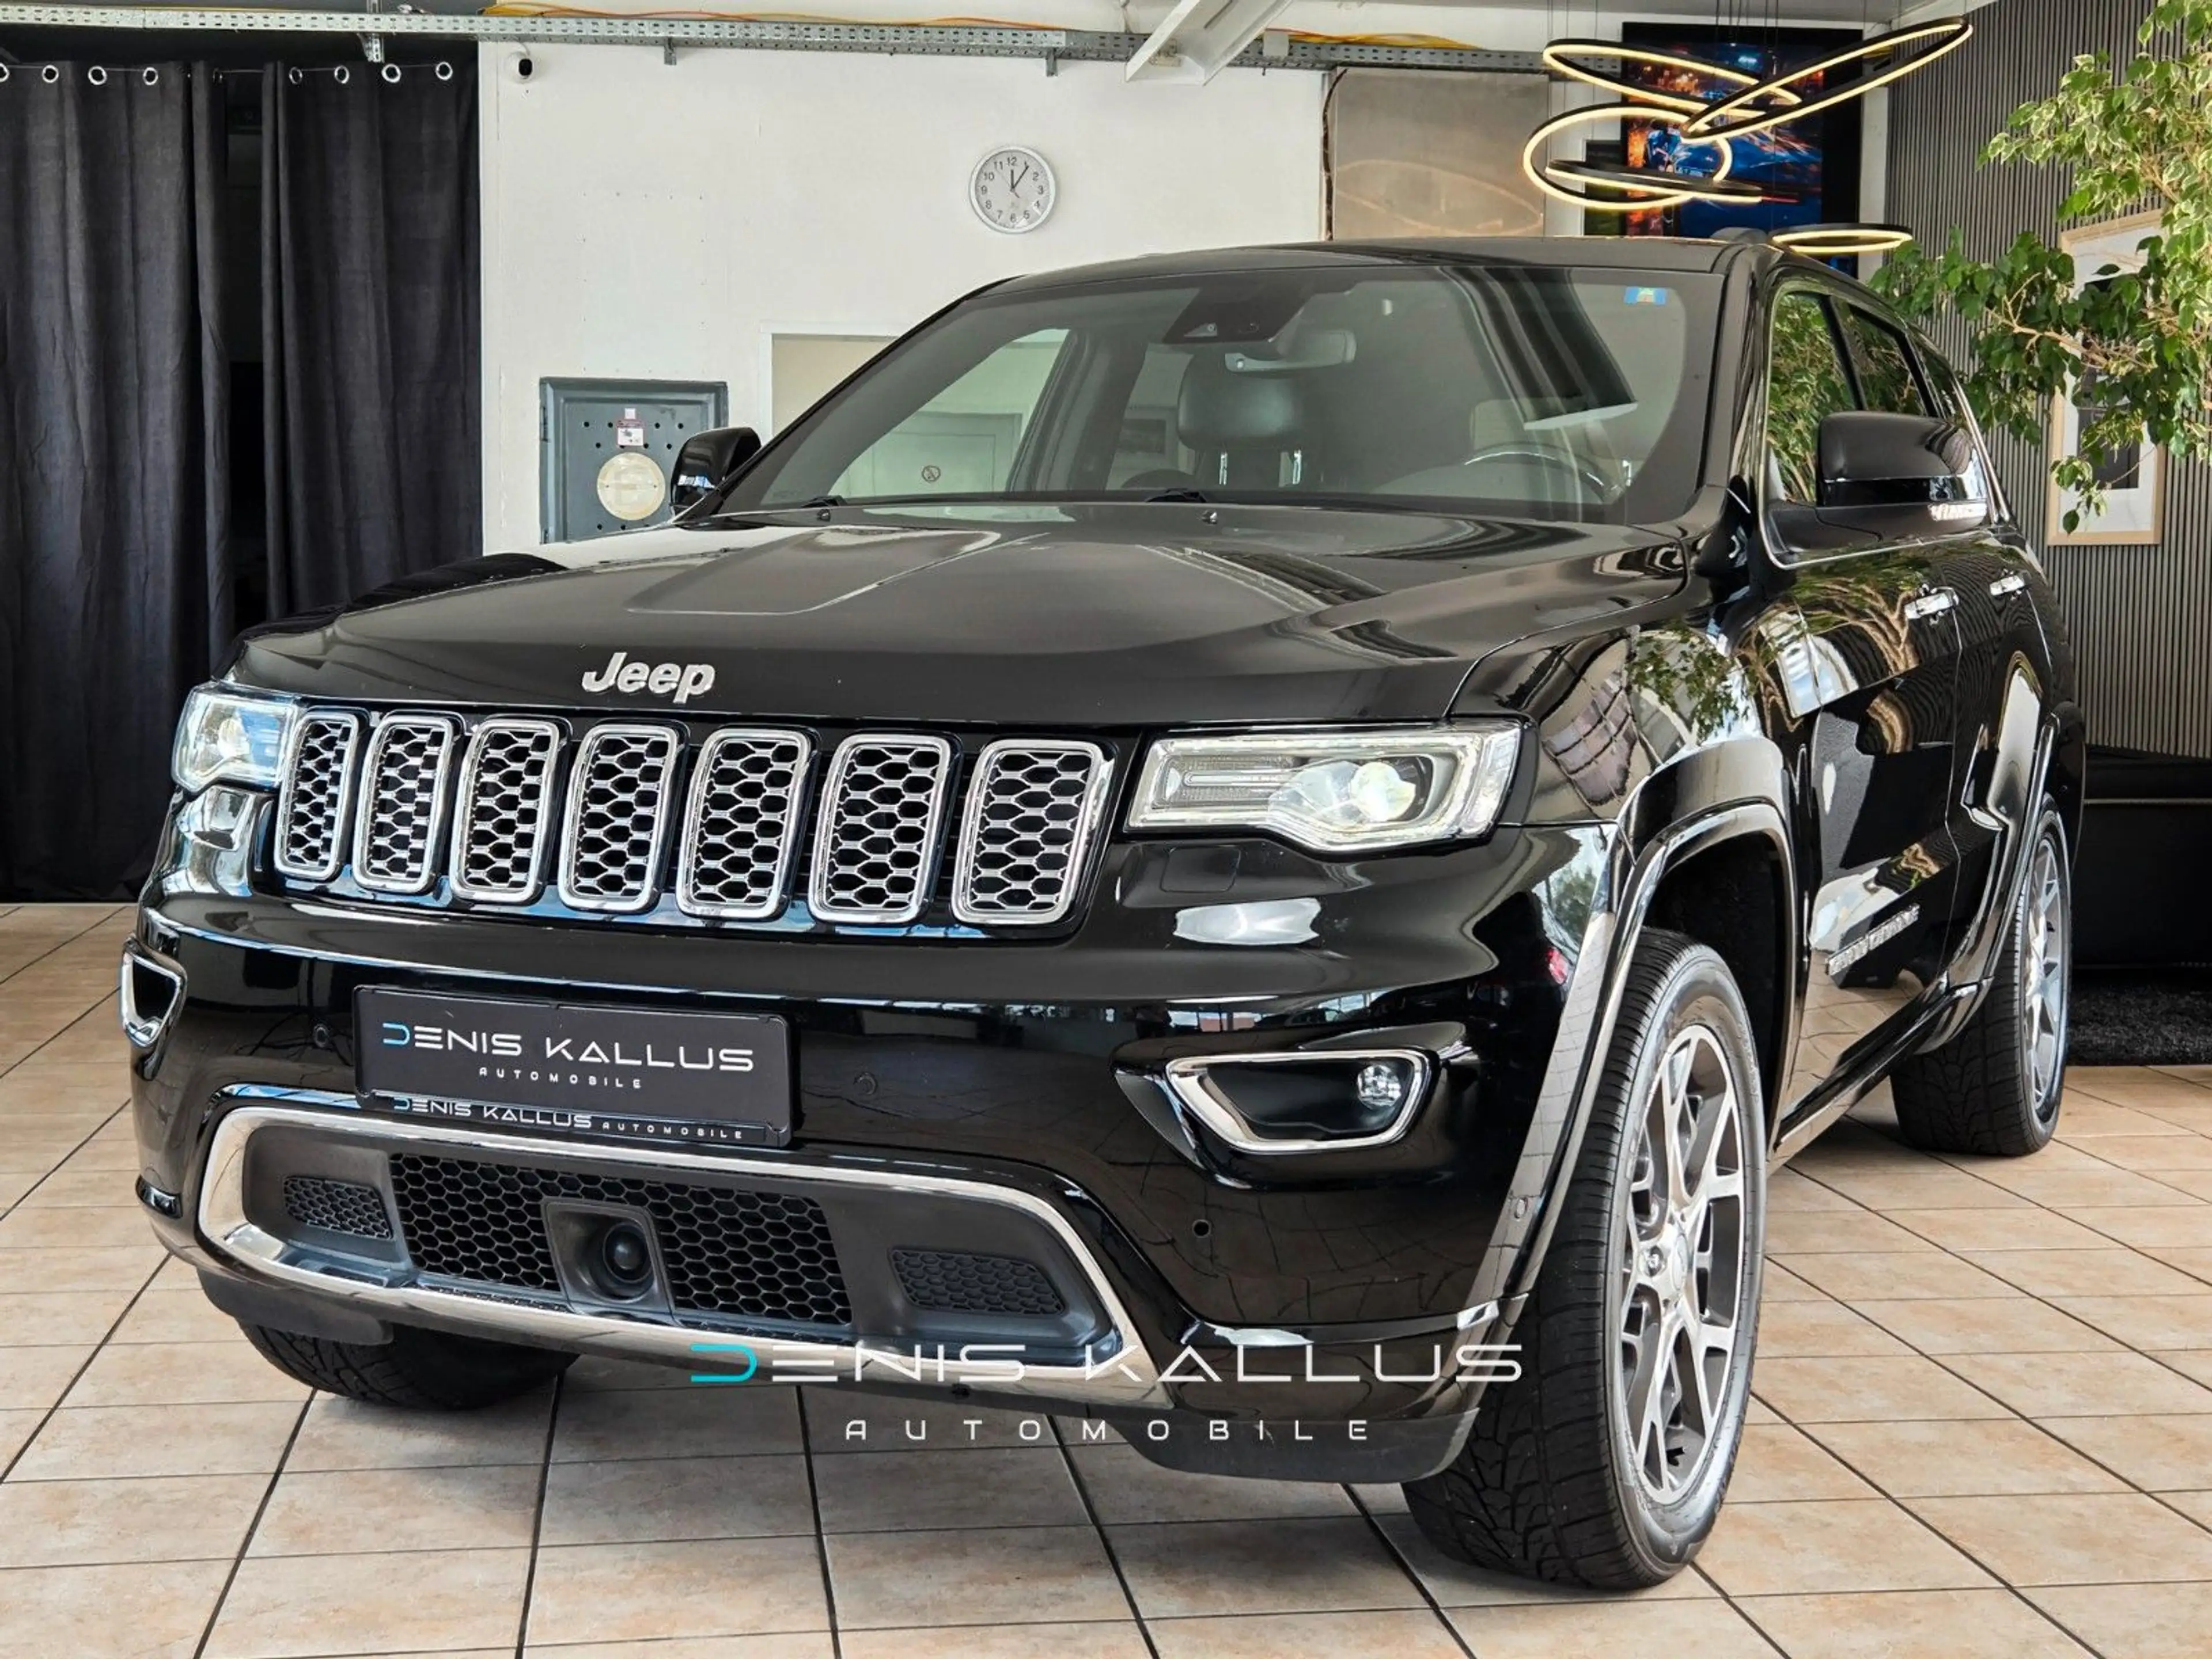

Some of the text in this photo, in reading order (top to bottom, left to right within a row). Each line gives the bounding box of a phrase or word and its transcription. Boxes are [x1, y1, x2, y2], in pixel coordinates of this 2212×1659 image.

[994, 161, 1003, 171] 11
[1006, 156, 1017, 166] 12
[983, 172, 995, 181] 10
[1032, 172, 1039, 181] 2
[980, 185, 988, 195] 9
[1037, 185, 1044, 195] 3
[985, 200, 992, 210] 8
[1033, 200, 1040, 208] 4
[997, 210, 1003, 219] 7
[1009, 213, 1017, 222] 6
[1023, 210, 1031, 219] 5
[582, 652, 715, 704] Jeep
[382, 1022, 754, 1072] DENIS KALLUS
[479, 1067, 642, 1089] AUTOMOBILE
[393, 1097, 743, 1139] DENIS KALLUS AUTOMOBILE
